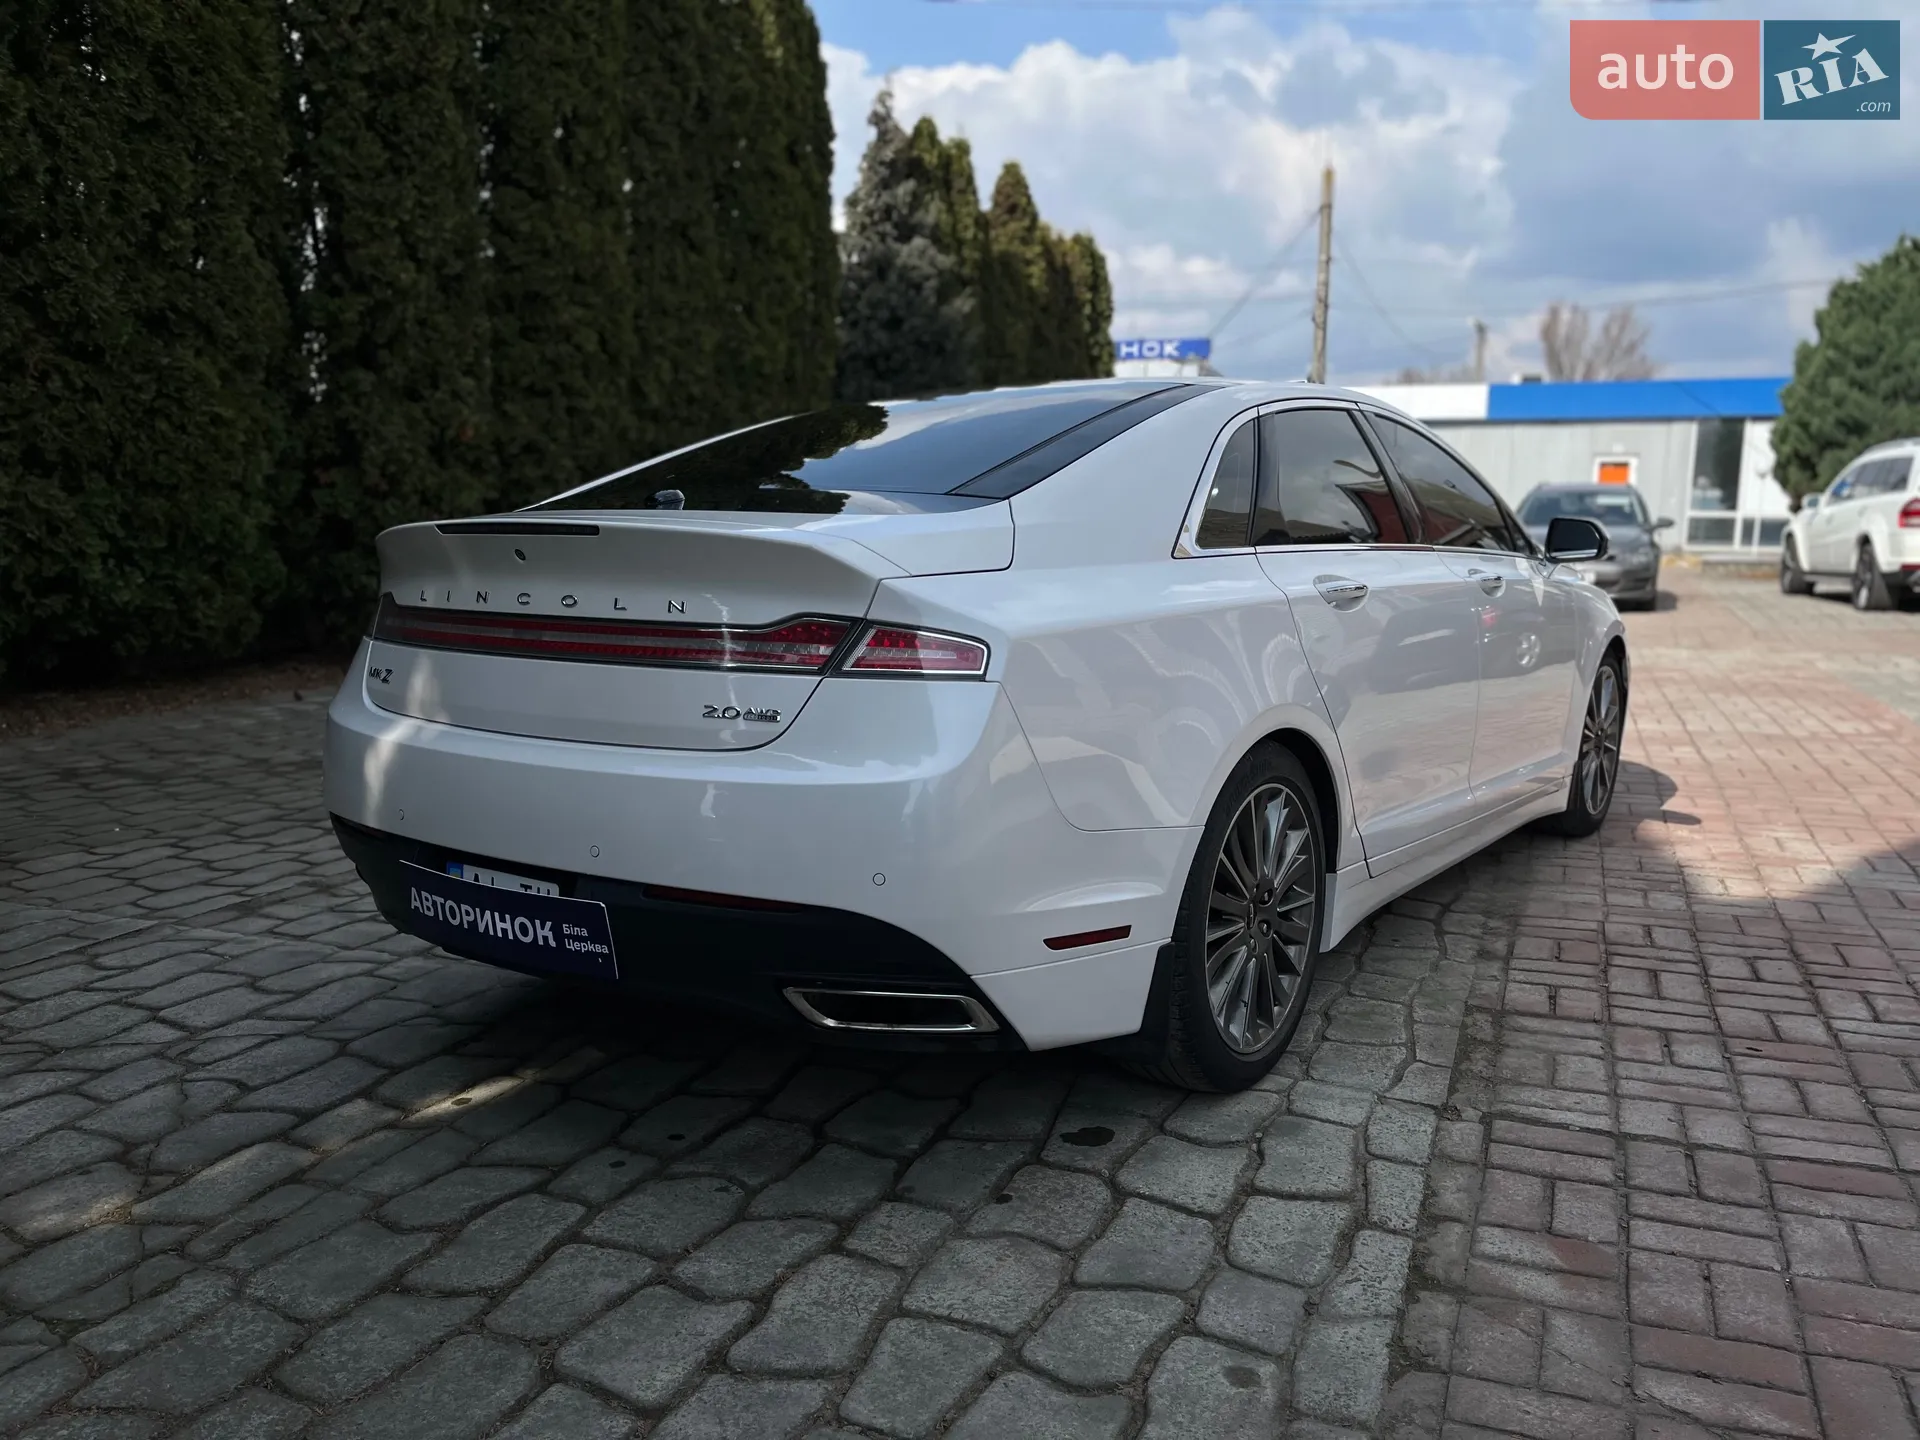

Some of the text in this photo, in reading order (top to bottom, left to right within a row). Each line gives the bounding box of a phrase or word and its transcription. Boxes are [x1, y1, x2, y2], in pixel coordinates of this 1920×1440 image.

[419, 589, 688, 614] LINCOLN
[369, 666, 394, 685] MKZ
[702, 704, 742, 720] 2.0
[410, 886, 557, 948] АВТОРИНОК
[562, 923, 589, 938] Біла
[564, 938, 609, 954] Церква
